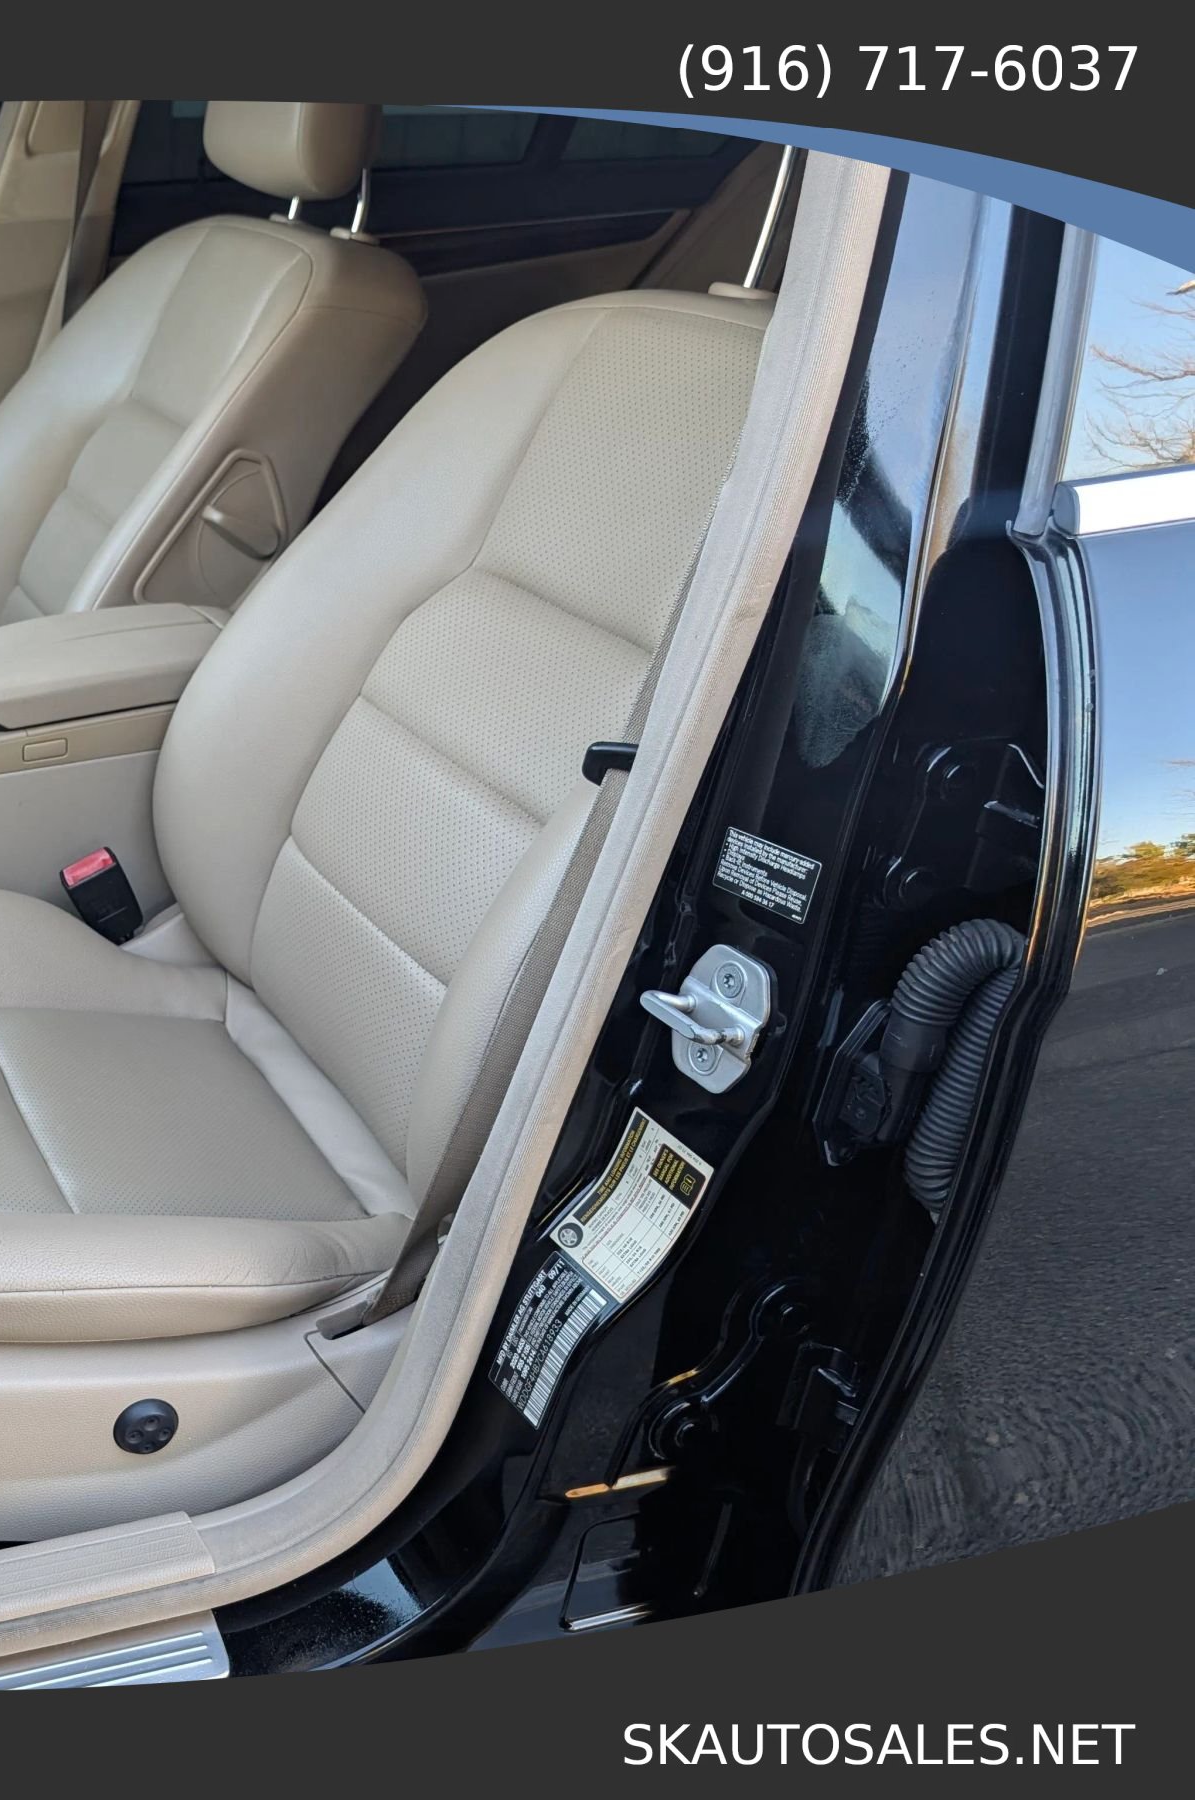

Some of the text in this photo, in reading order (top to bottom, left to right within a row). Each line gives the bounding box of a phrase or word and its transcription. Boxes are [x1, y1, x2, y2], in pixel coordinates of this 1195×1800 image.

[535, 1283, 546, 1298] 040
[547, 1259, 565, 1280] 09/11
[506, 1313, 521, 1342] DAIMLER
[517, 1303, 525, 1315] AG
[522, 1269, 546, 1305] STUTTGART
[509, 1352, 519, 1368] 2020
